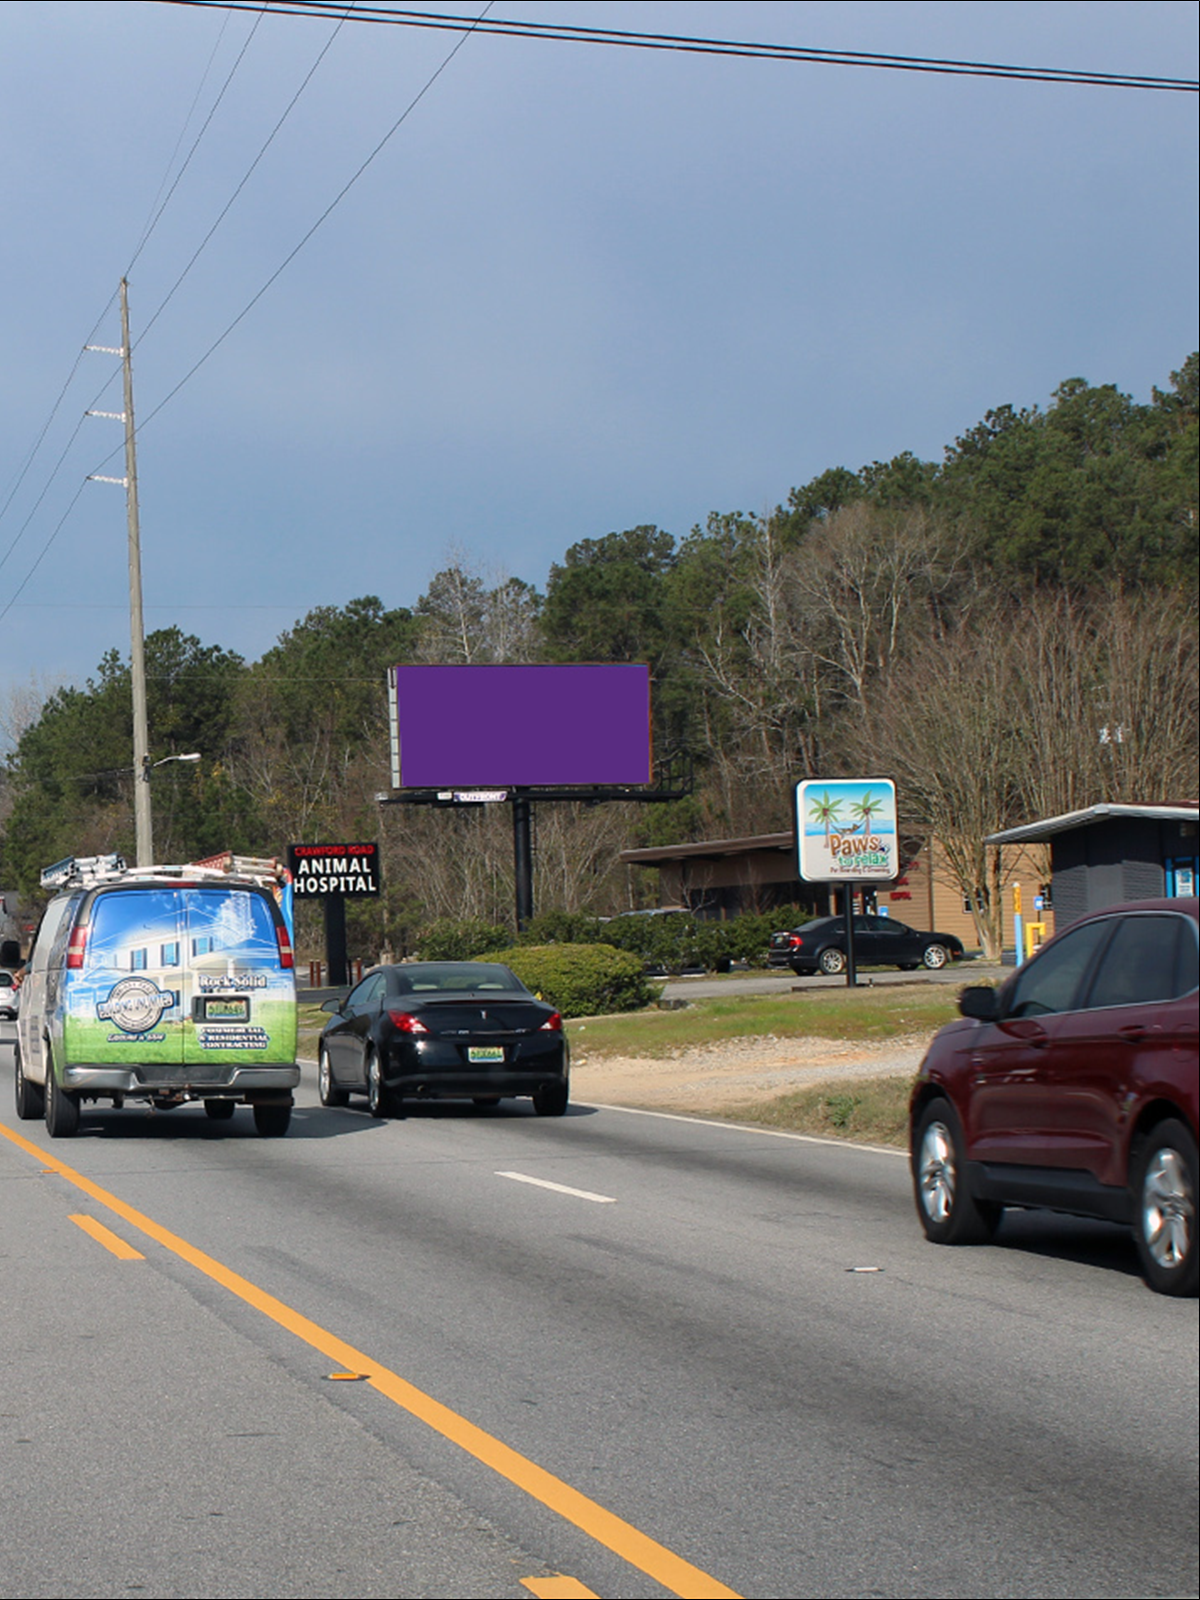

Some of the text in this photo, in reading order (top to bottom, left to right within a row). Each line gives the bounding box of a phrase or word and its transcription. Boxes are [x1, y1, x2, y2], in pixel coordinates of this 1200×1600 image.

[294, 845, 375, 856] CRAWFORD ROAD
[829, 834, 880, 856] Paws
[298, 857, 371, 874] ANIMAL
[838, 852, 887, 866] to relax
[293, 875, 376, 893] HOSPITAL
